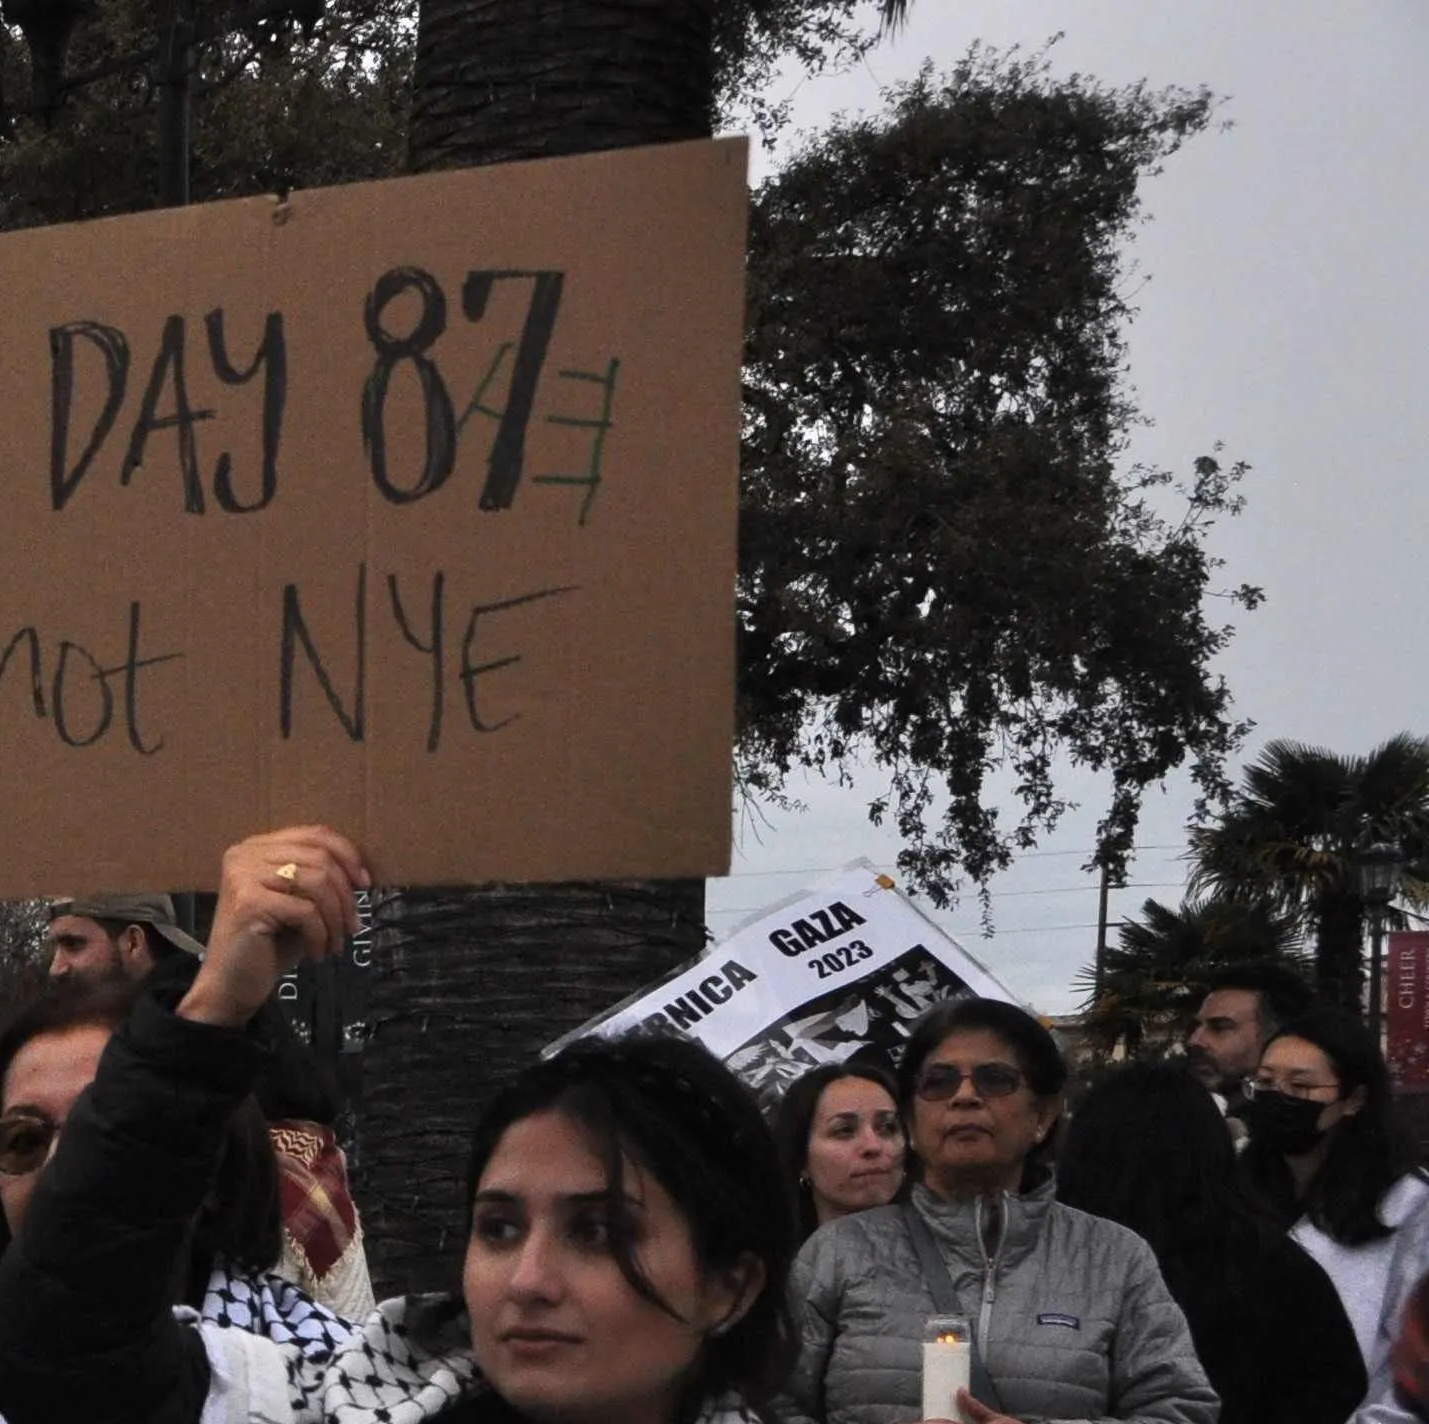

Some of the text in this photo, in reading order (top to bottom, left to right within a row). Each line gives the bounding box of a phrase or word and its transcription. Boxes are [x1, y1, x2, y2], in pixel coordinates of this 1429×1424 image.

[49, 305, 288, 516] DAY
[280, 561, 583, 754] NYE
[768, 900, 868, 958] GAZA
[806, 938, 875, 980] 2023
[631, 958, 759, 1034] RNICA
[1397, 948, 1416, 1010] CHEER
